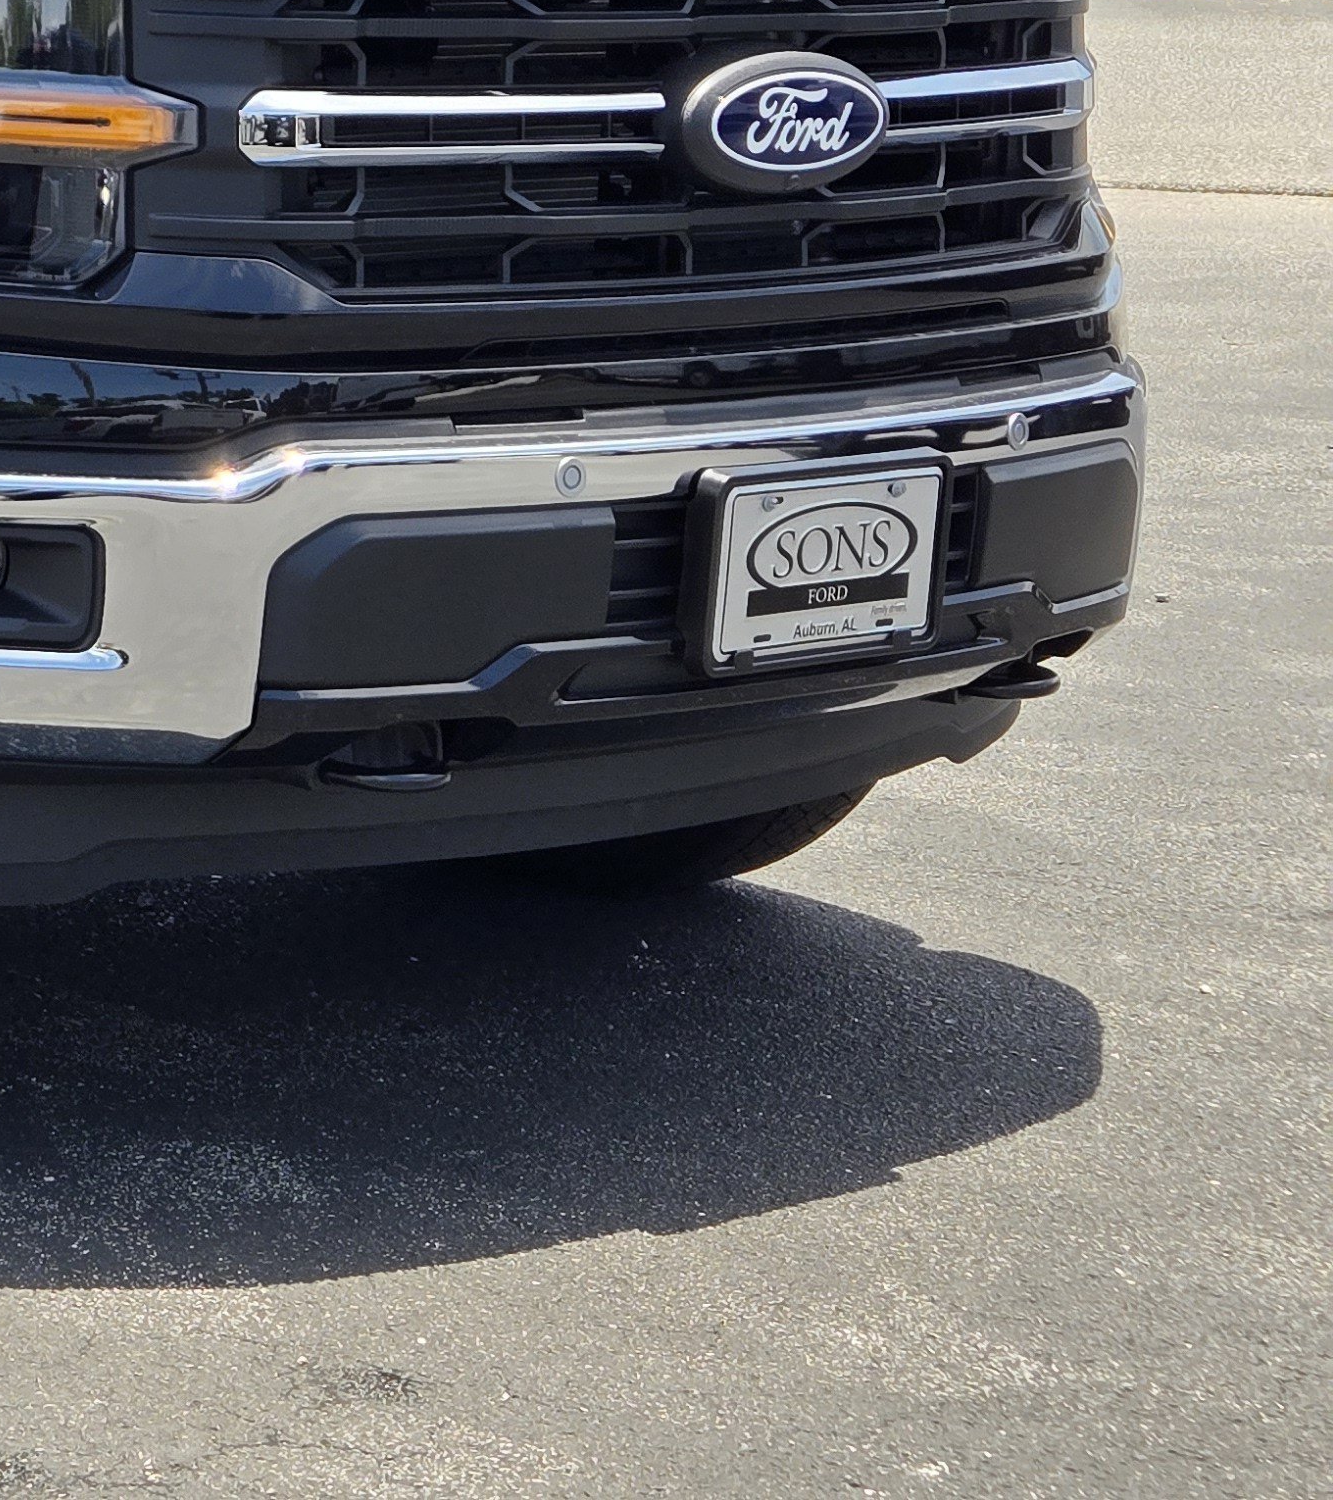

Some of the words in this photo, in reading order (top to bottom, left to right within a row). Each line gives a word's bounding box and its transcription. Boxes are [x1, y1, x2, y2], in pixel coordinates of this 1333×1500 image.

[746, 86, 854, 154] Ford
[772, 520, 891, 579] SONS
[808, 585, 849, 605] FORD
[793, 623, 839, 640] Auburn,
[841, 617, 858, 633] AL
